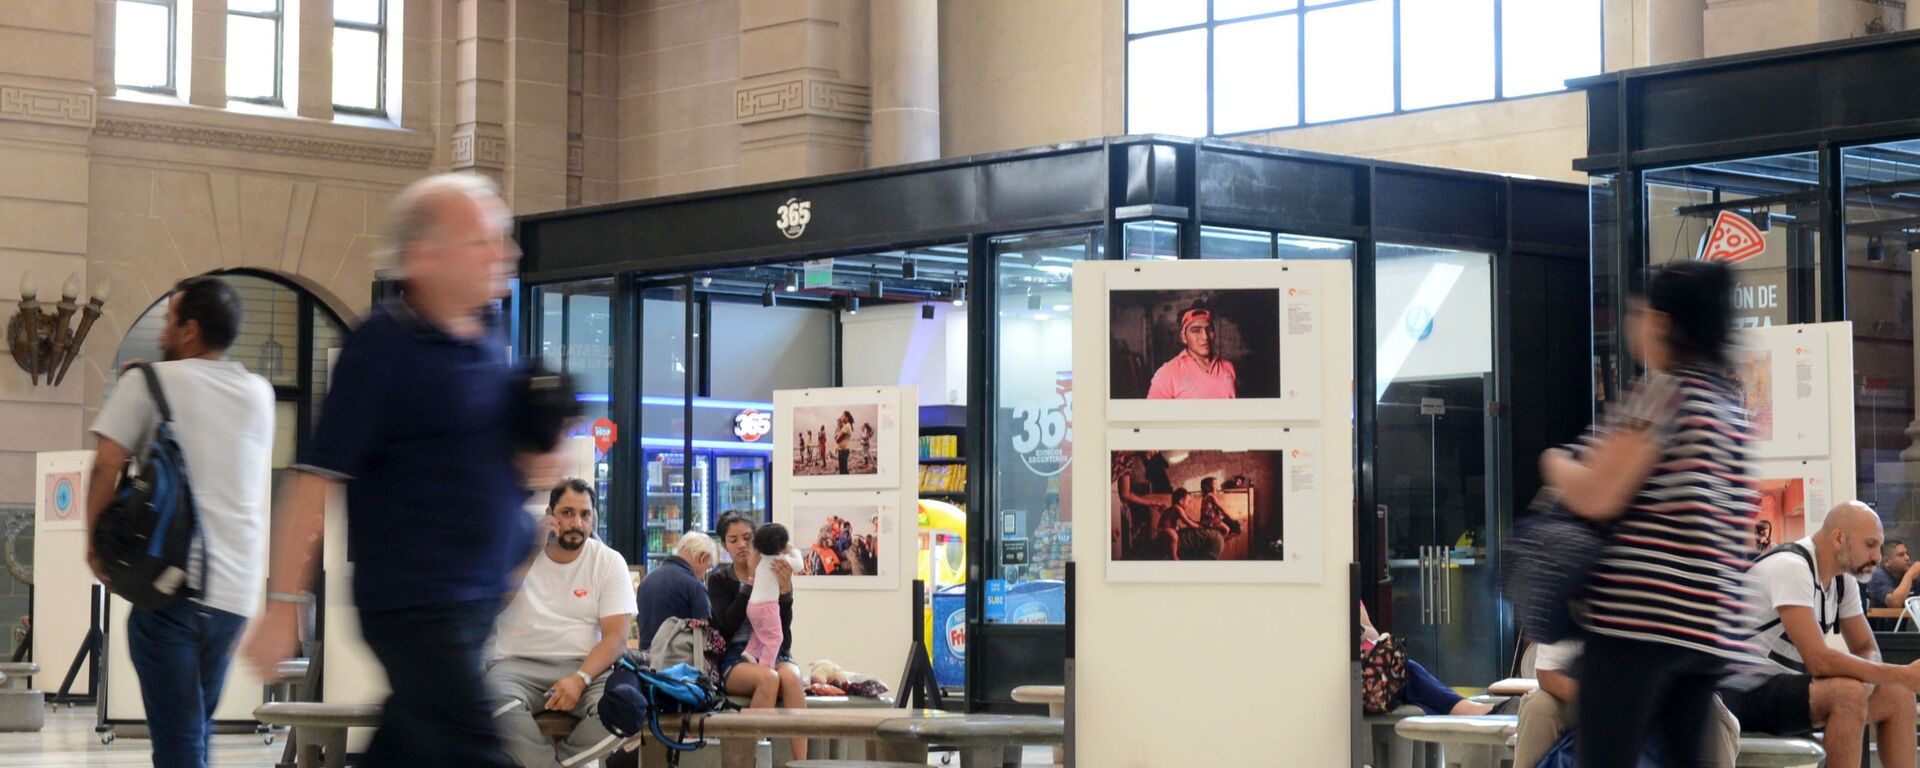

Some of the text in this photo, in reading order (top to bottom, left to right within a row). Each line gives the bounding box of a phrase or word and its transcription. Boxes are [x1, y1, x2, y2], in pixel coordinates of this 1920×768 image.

[776, 201, 811, 229] 365
[1758, 284, 1777, 308] DE
[734, 412, 771, 438] 365
[987, 595, 1004, 605] SUBE
[951, 627, 966, 647] Fri
